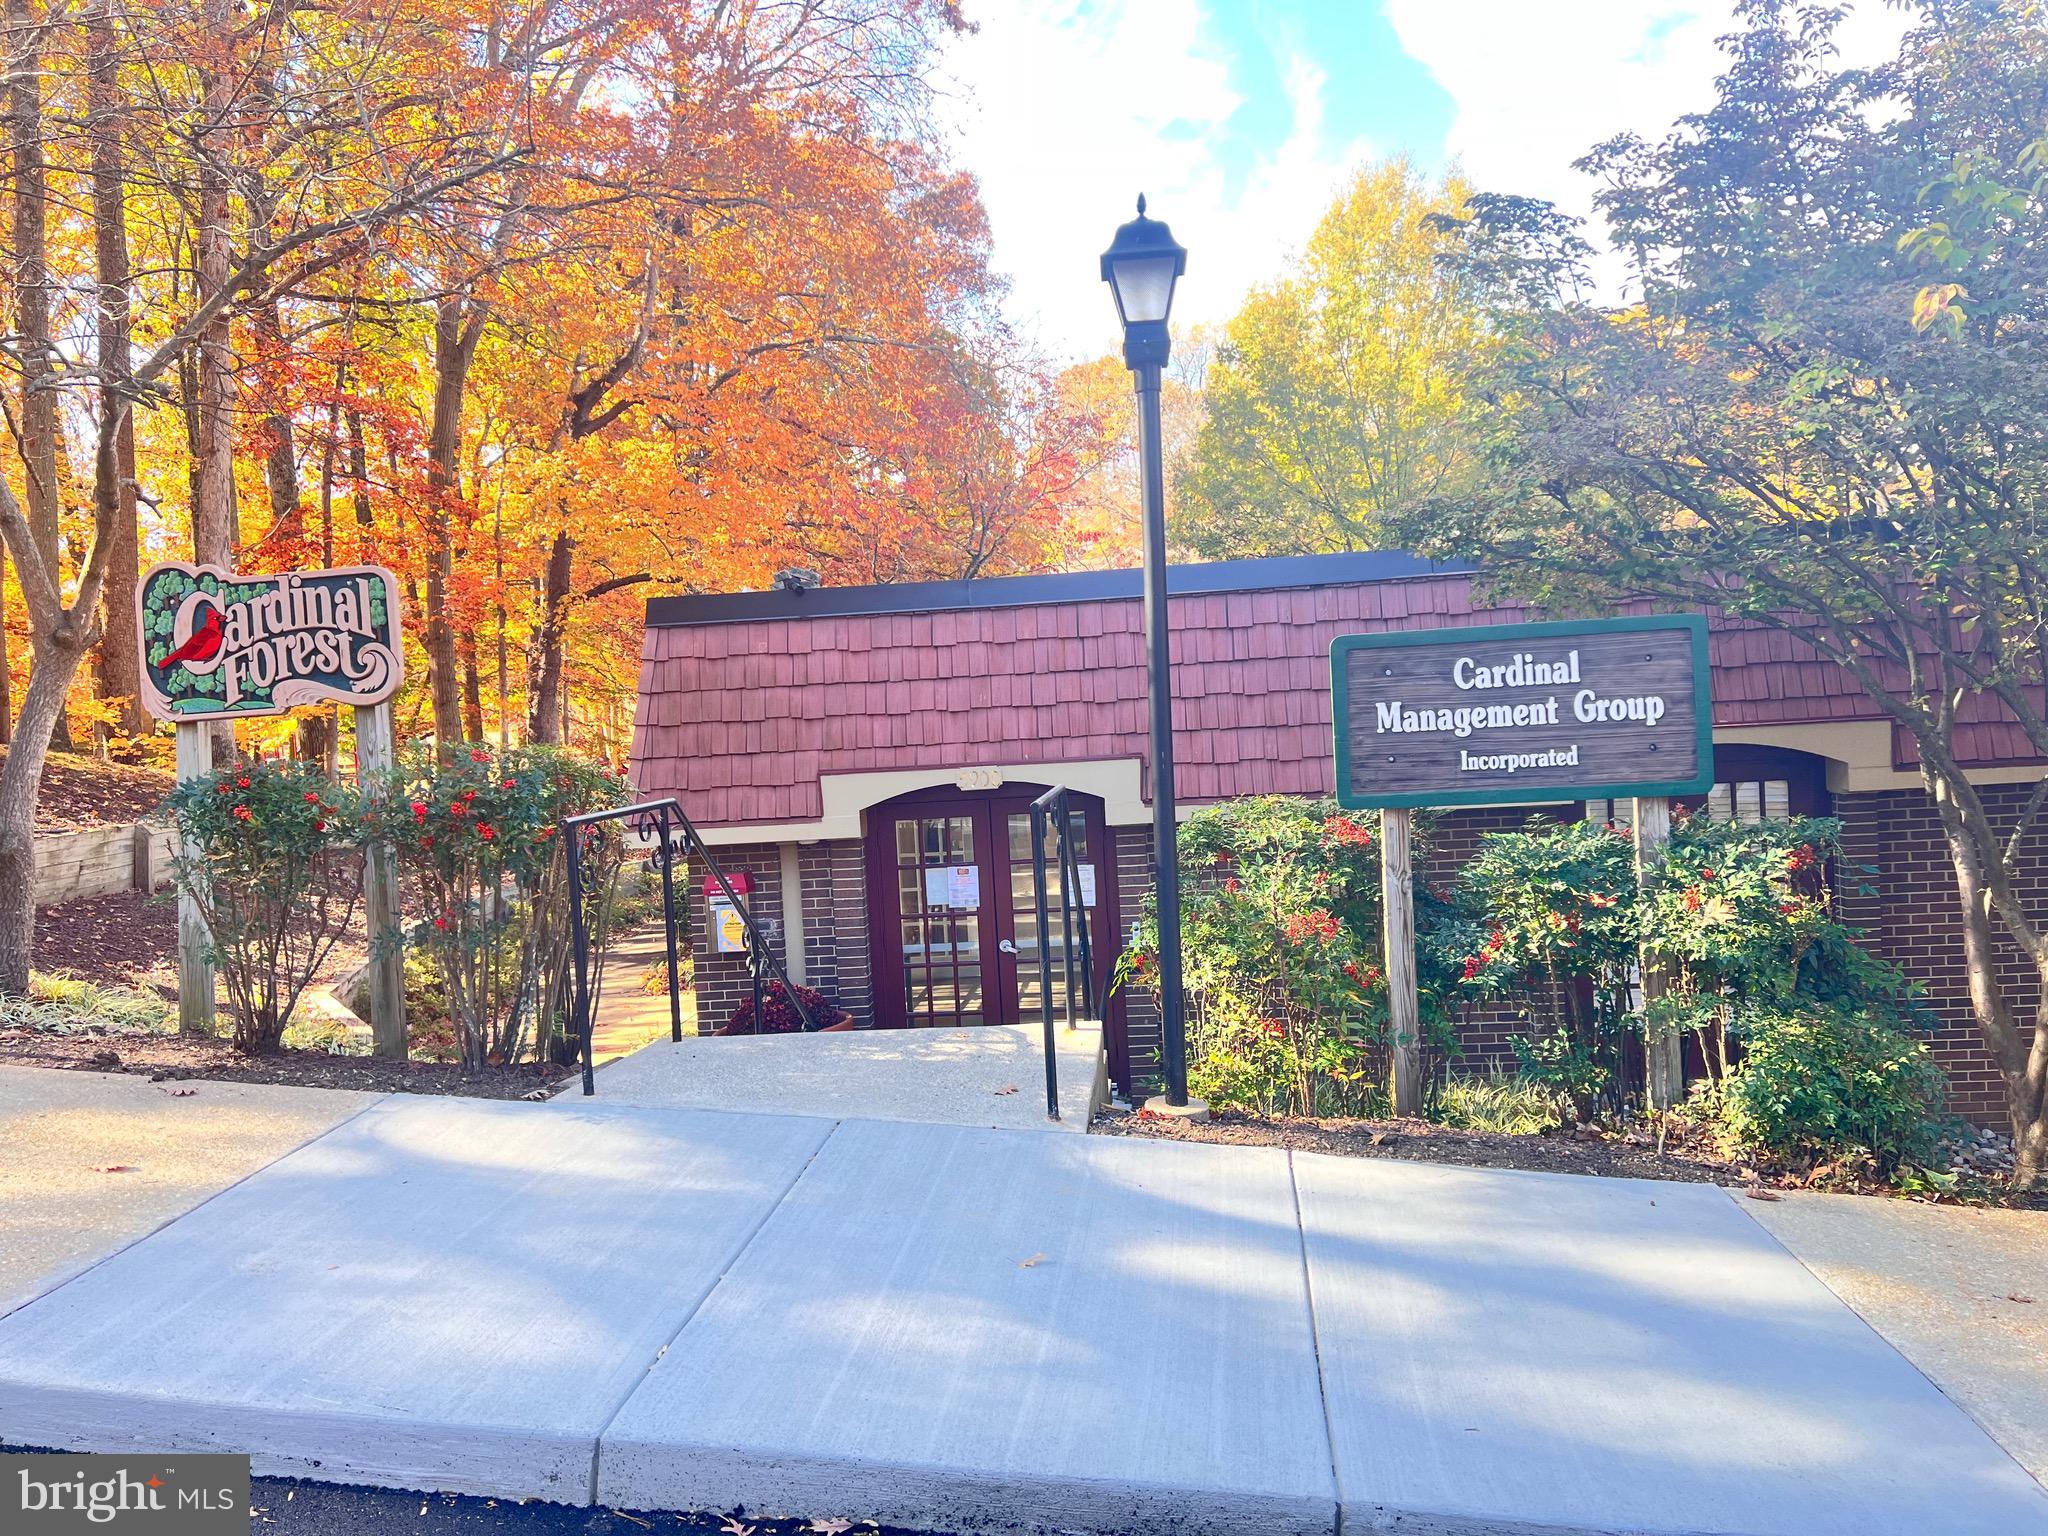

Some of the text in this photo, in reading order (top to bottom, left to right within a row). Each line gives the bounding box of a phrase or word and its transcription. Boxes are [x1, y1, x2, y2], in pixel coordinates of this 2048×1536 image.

[174, 574, 376, 676] Cardinal
[221, 629, 376, 708] Forest
[1453, 650, 1581, 689] Cardinal
[1375, 689, 1665, 737] Management Group
[1460, 745, 1579, 772] Incorporated
